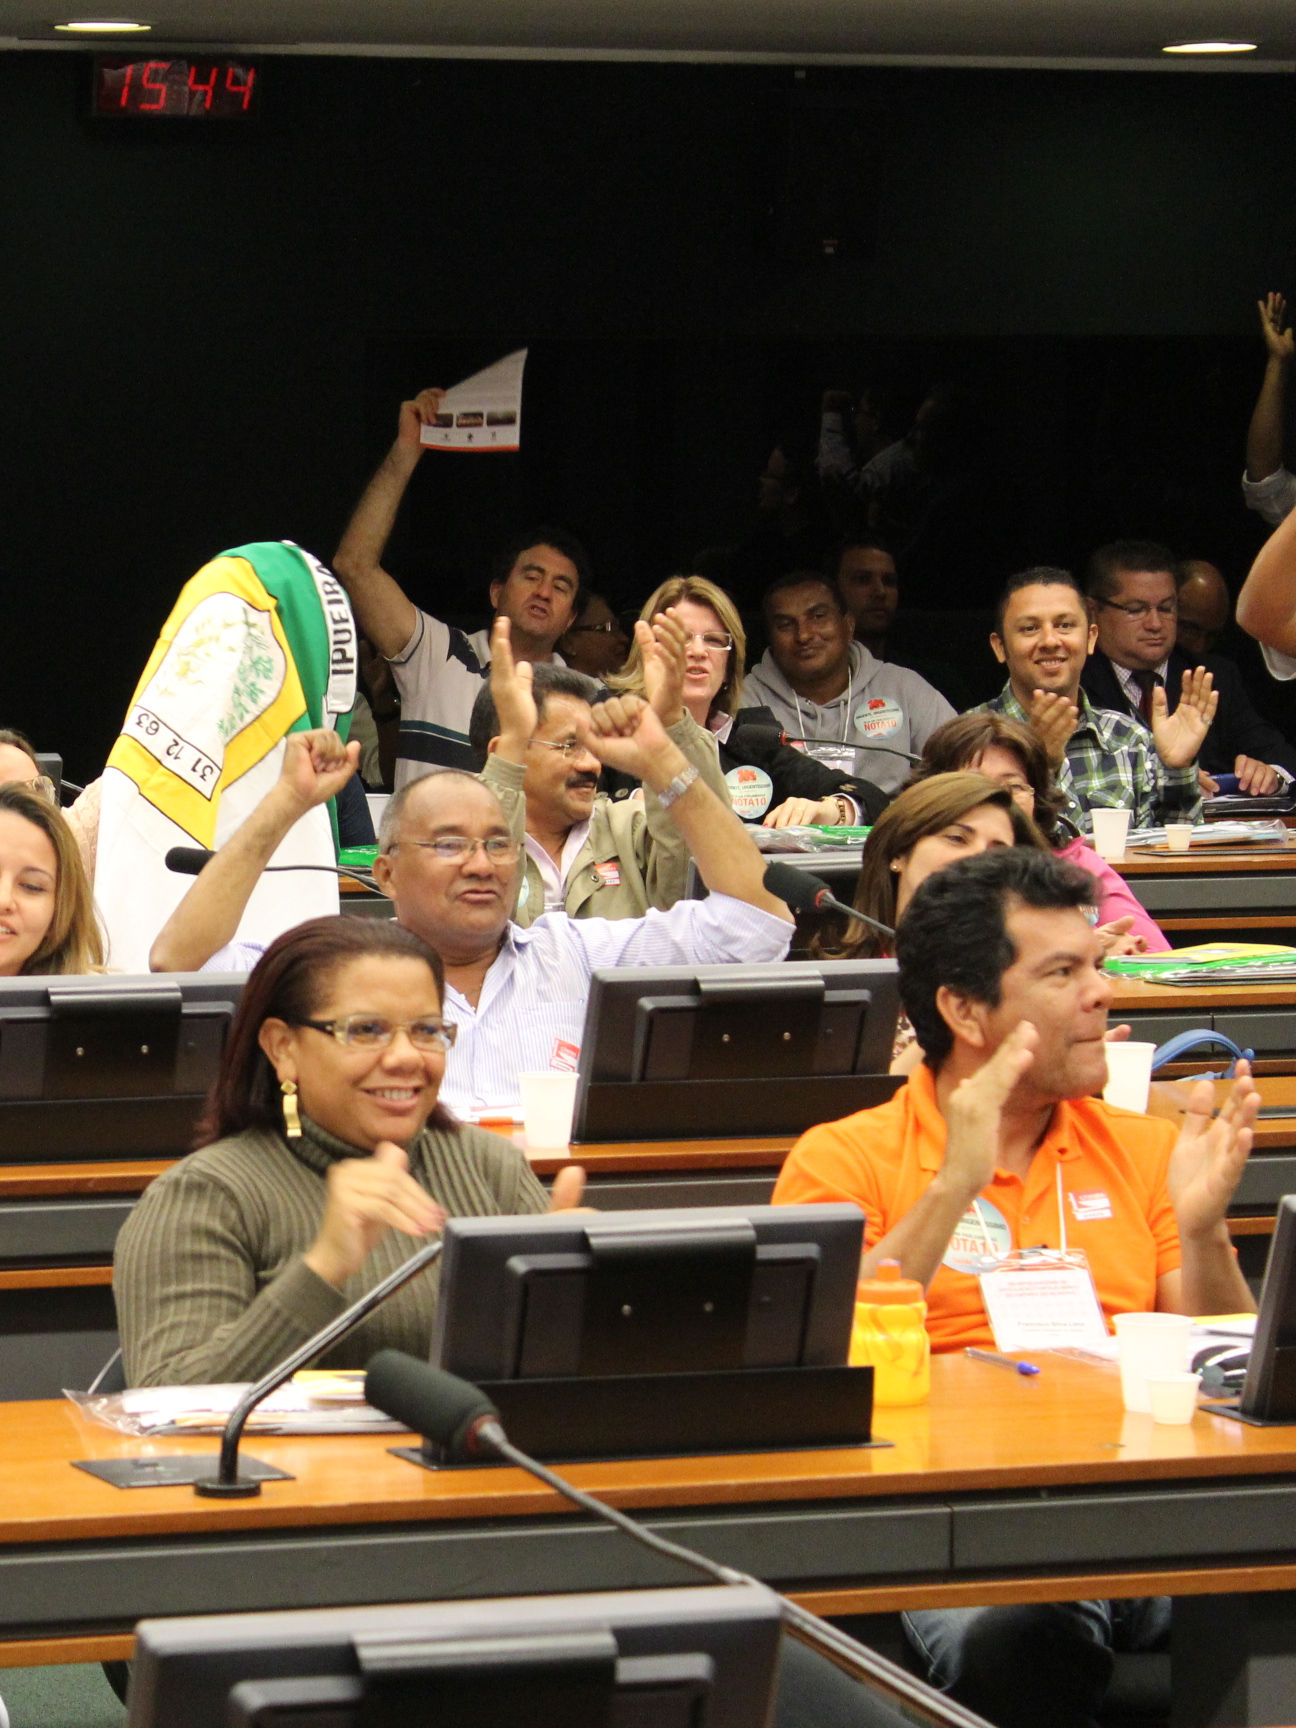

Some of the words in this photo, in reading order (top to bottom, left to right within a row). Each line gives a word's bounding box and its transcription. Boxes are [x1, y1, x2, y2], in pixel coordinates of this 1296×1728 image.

[135, 713, 160, 736] 63
[166, 738, 184, 760] 12
[191, 757, 214, 782] 31
